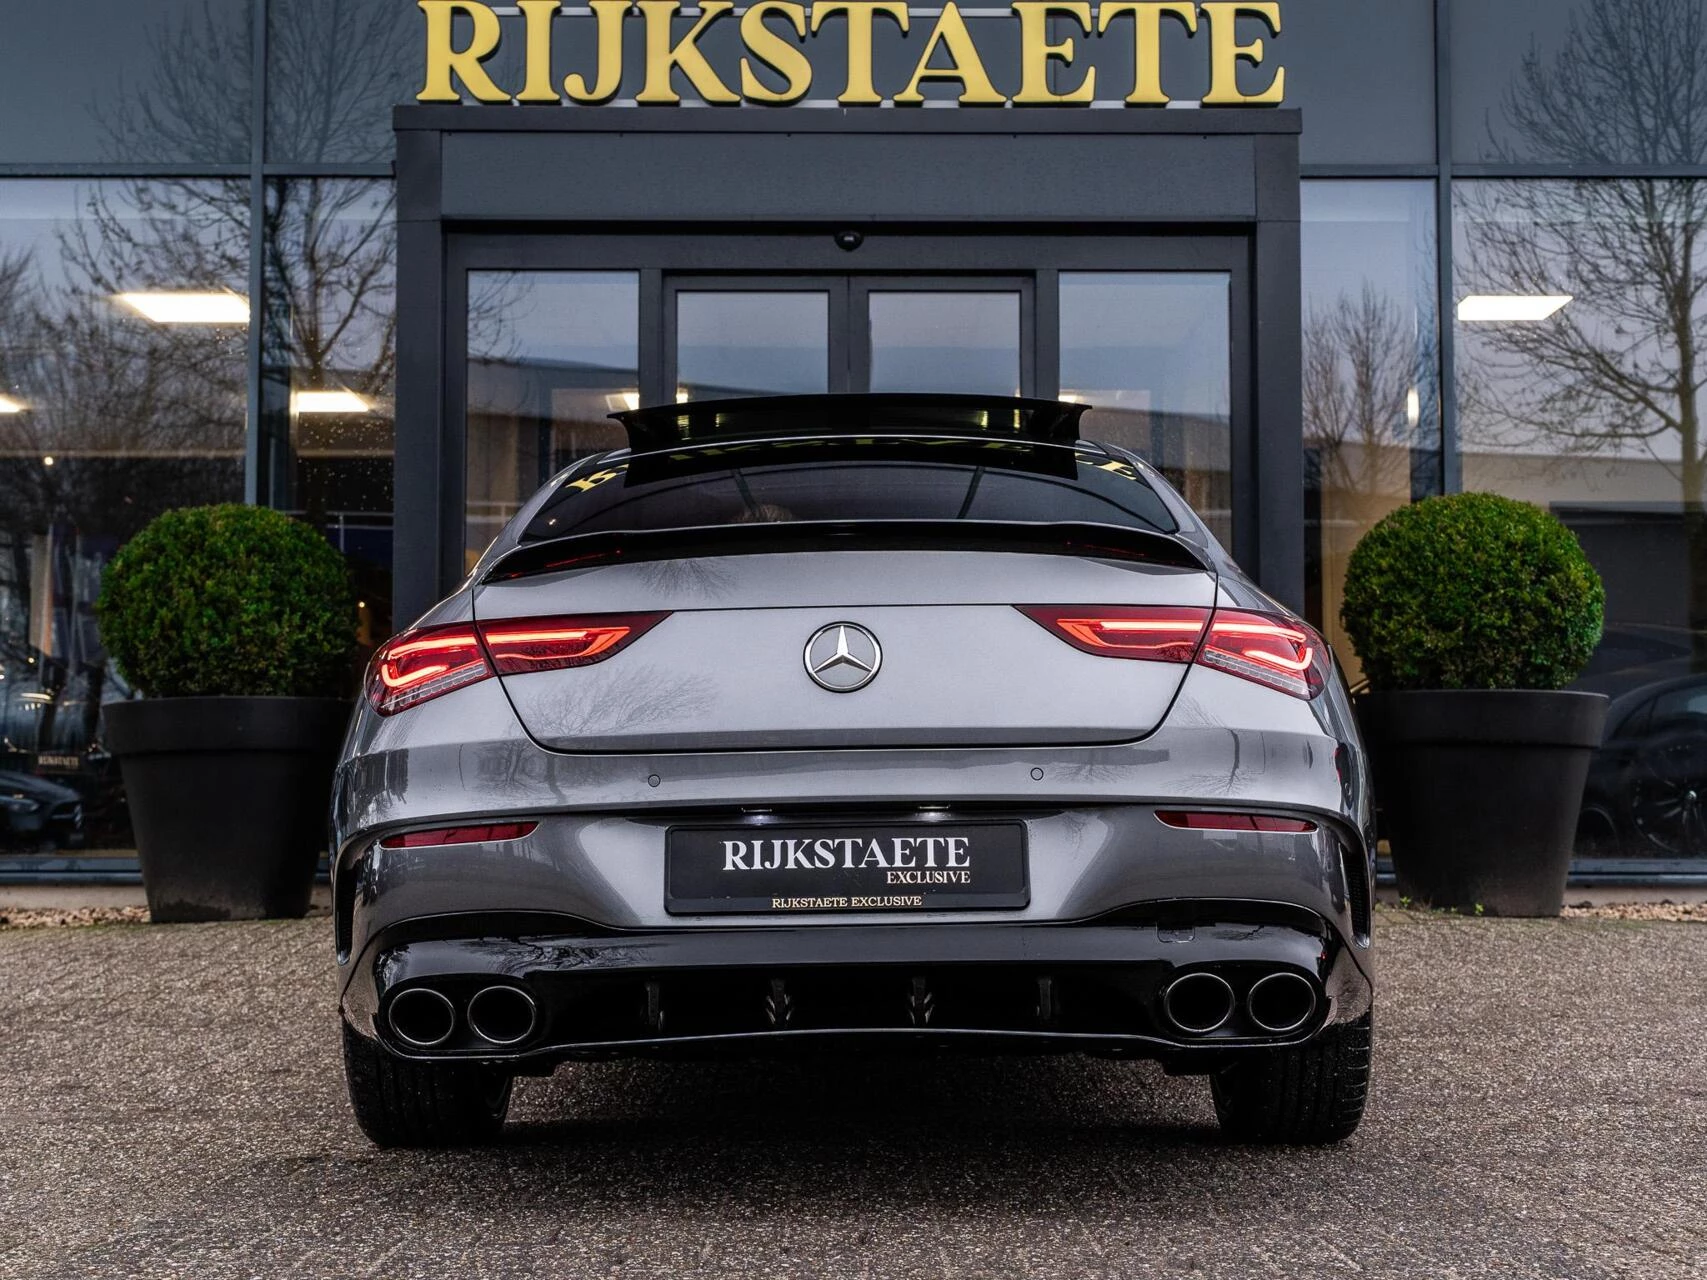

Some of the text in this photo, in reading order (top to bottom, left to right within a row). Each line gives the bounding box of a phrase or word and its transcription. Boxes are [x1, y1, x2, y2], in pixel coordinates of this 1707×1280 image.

[416, 0, 1286, 104] RIJKSTAETE
[722, 837, 970, 871] RIJKSTAETE
[886, 871, 971, 884] EXCLUSIVE
[772, 896, 922, 908] RIJKSTAETE EXCLUSIVE
